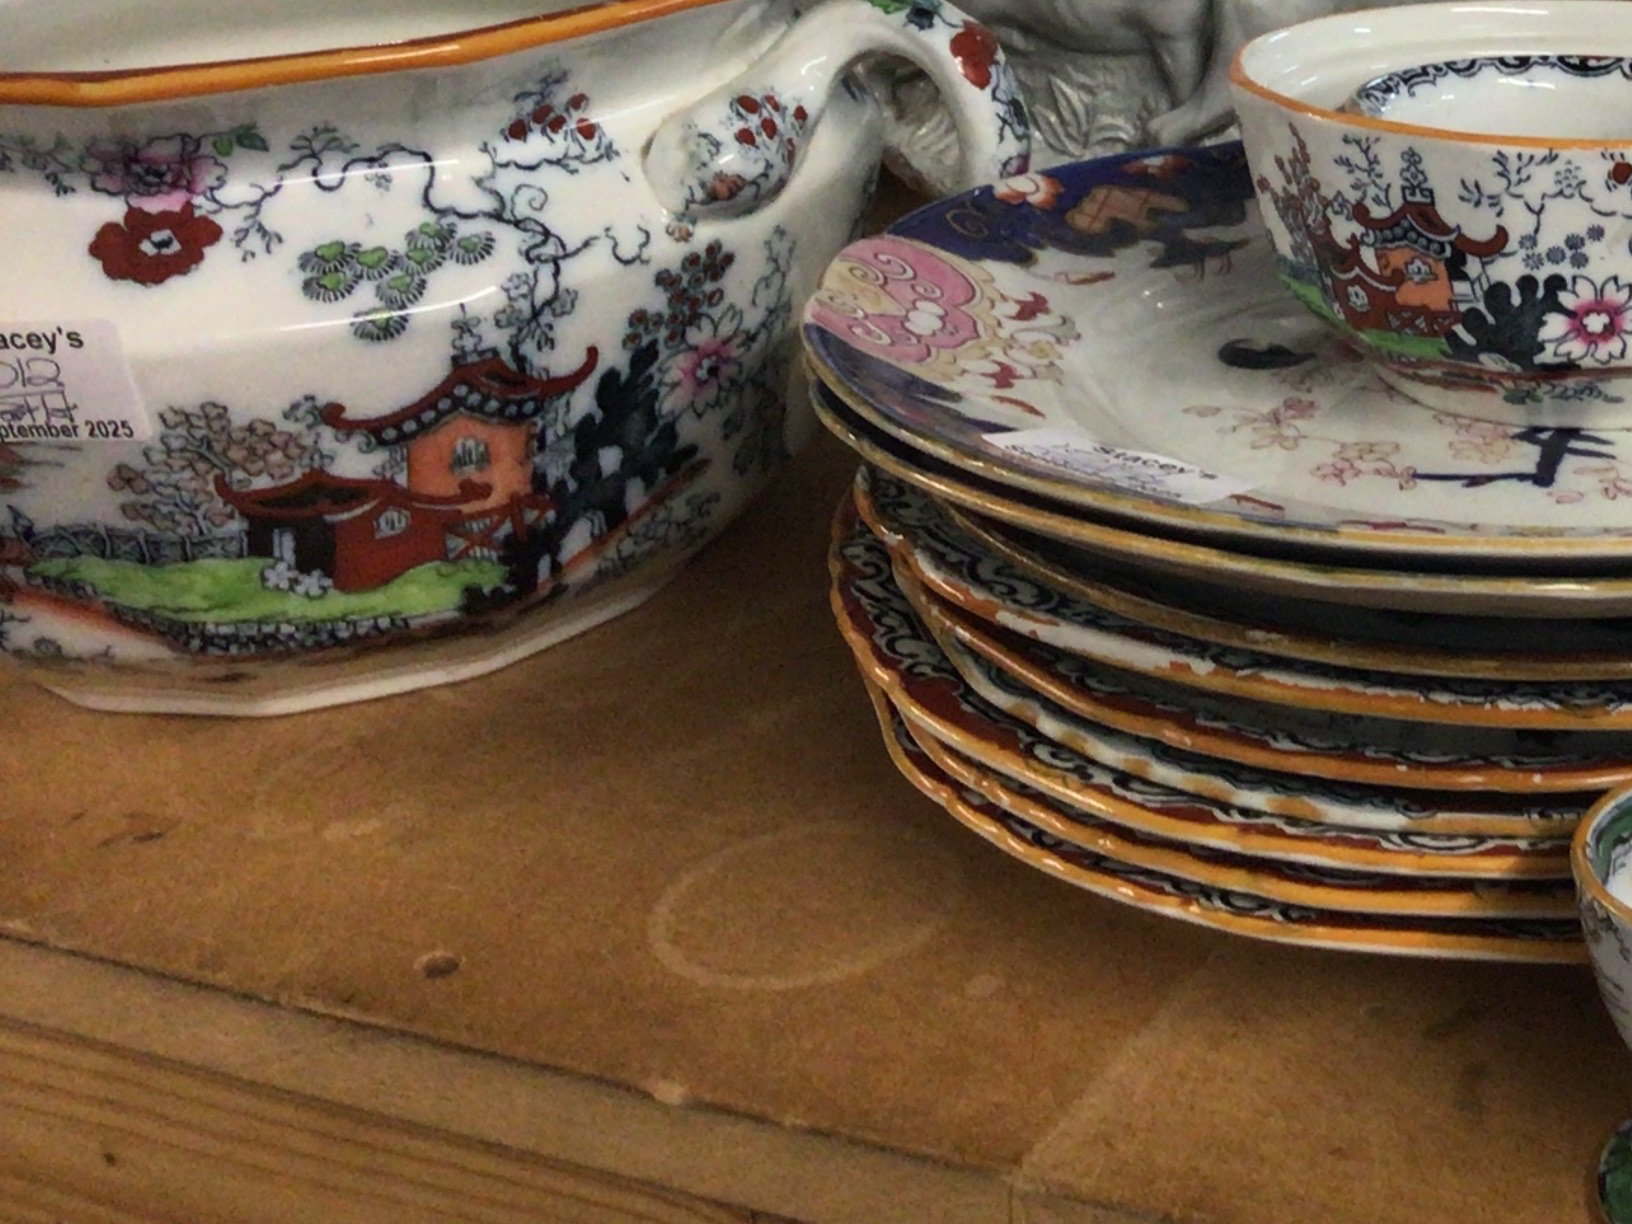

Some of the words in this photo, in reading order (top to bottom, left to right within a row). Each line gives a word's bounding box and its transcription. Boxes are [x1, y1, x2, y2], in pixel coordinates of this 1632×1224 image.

[0, 326, 84, 355] acey's
[0, 357, 65, 388] 012
[0, 422, 79, 443] ptember
[85, 420, 134, 439] 2025
